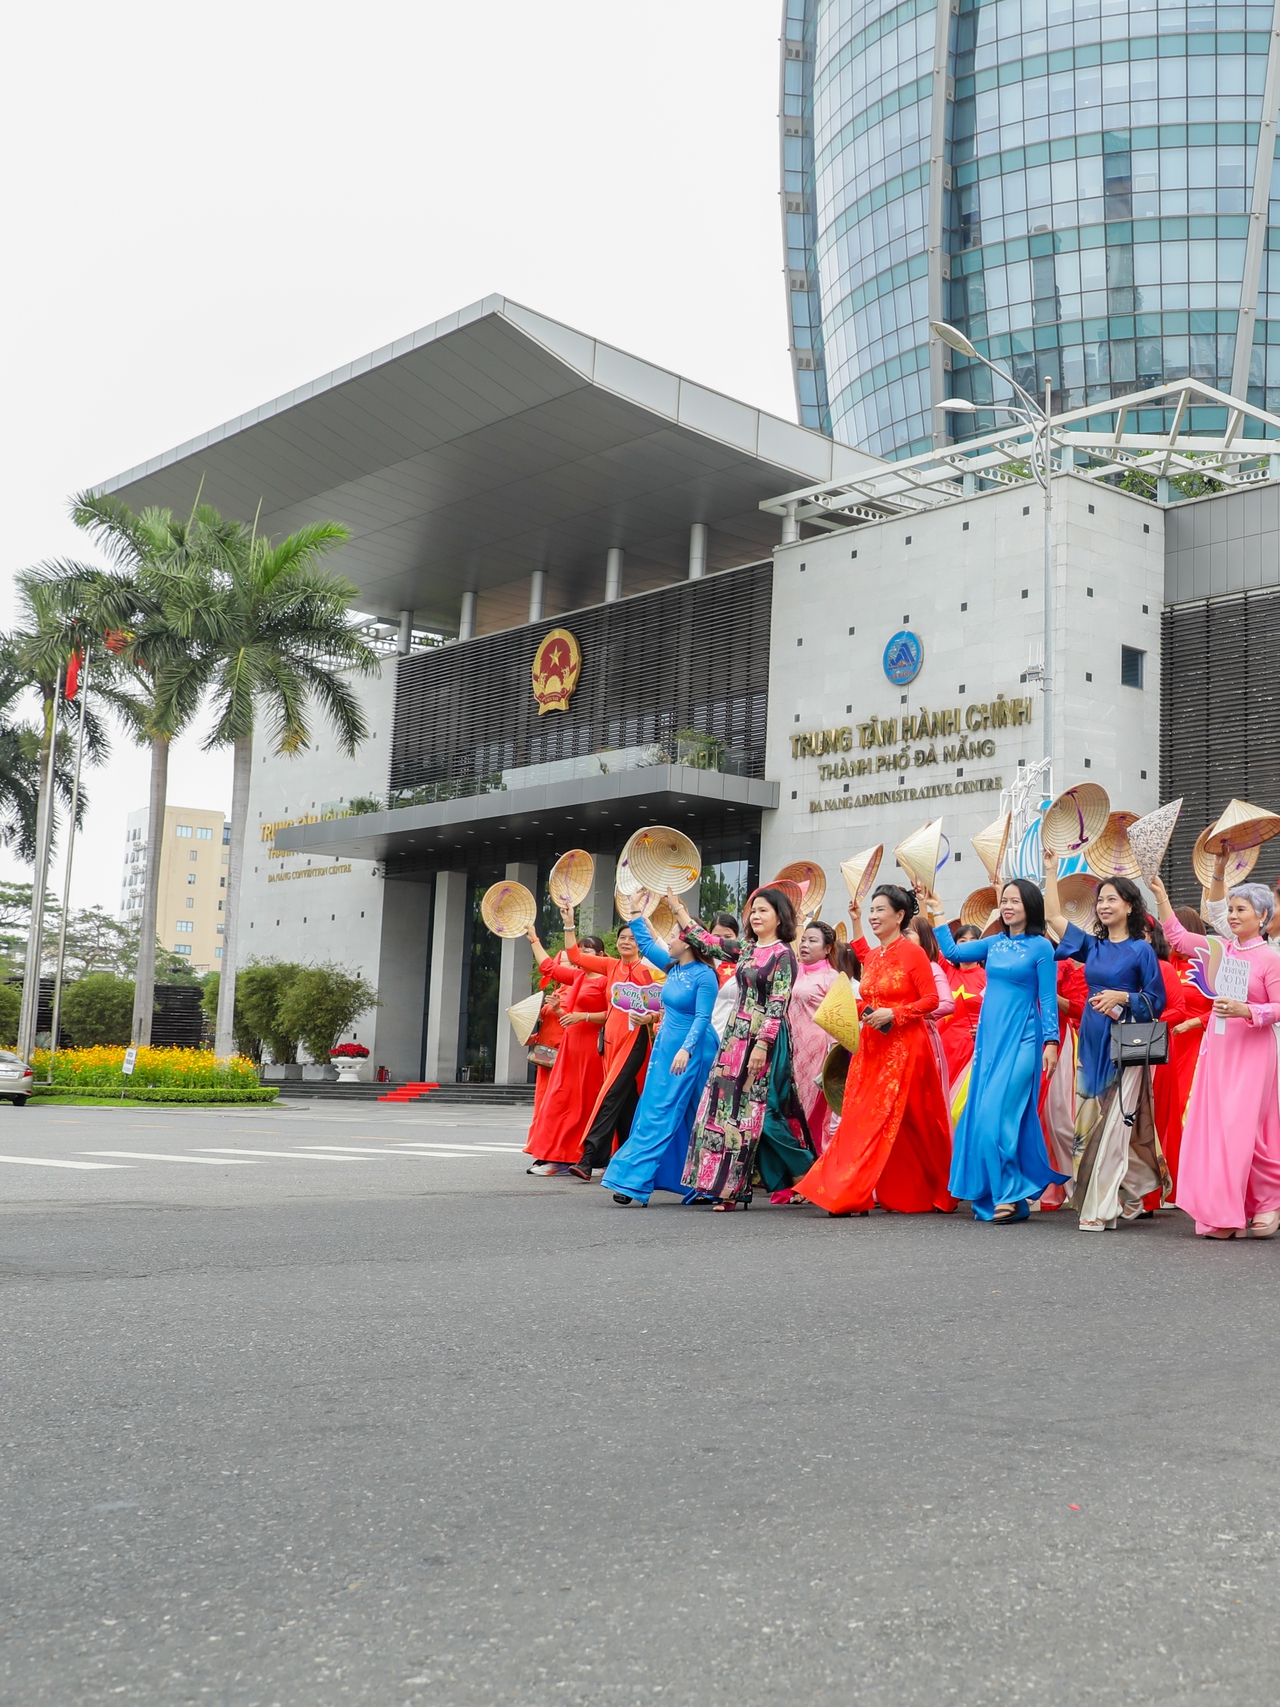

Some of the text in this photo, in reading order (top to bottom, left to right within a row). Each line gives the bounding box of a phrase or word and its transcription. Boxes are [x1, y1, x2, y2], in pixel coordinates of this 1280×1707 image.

[789, 693, 1032, 760] TRUNG TÂM HÀNH CHÍNH
[818, 734, 995, 781] THÀNH PHỐ ĐÀ NẴNG
[809, 776, 1003, 813] DA NANG ADMINISTRATIVE CENTRE
[291, 867, 328, 879] CONVENTION
[328, 863, 352, 875] CENTRE
